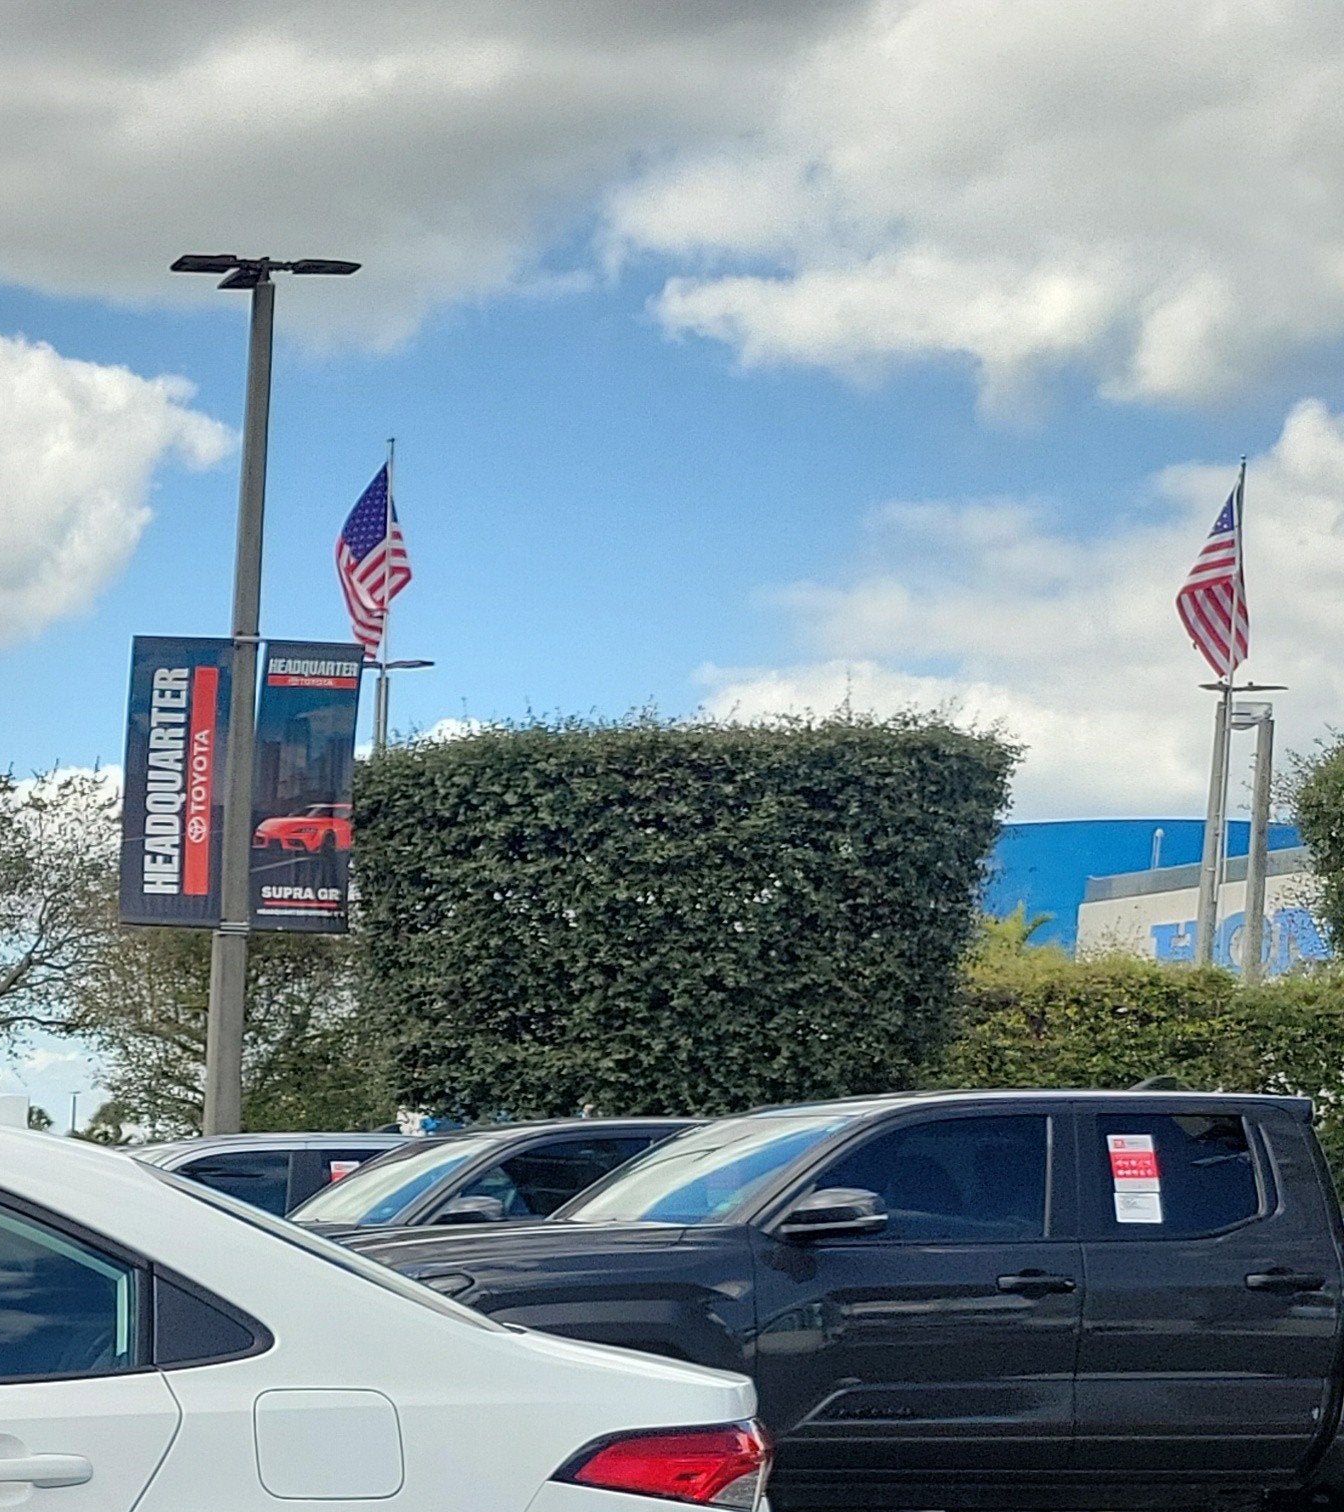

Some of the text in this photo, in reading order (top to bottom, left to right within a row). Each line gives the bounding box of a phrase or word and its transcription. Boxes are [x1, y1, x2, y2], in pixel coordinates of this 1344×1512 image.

[269, 658, 358, 677] HEADQUARTER
[143, 667, 189, 894] HEADQUARTER
[190, 729, 211, 814] TOYOTA
[261, 886, 340, 901] SUPRA GR
